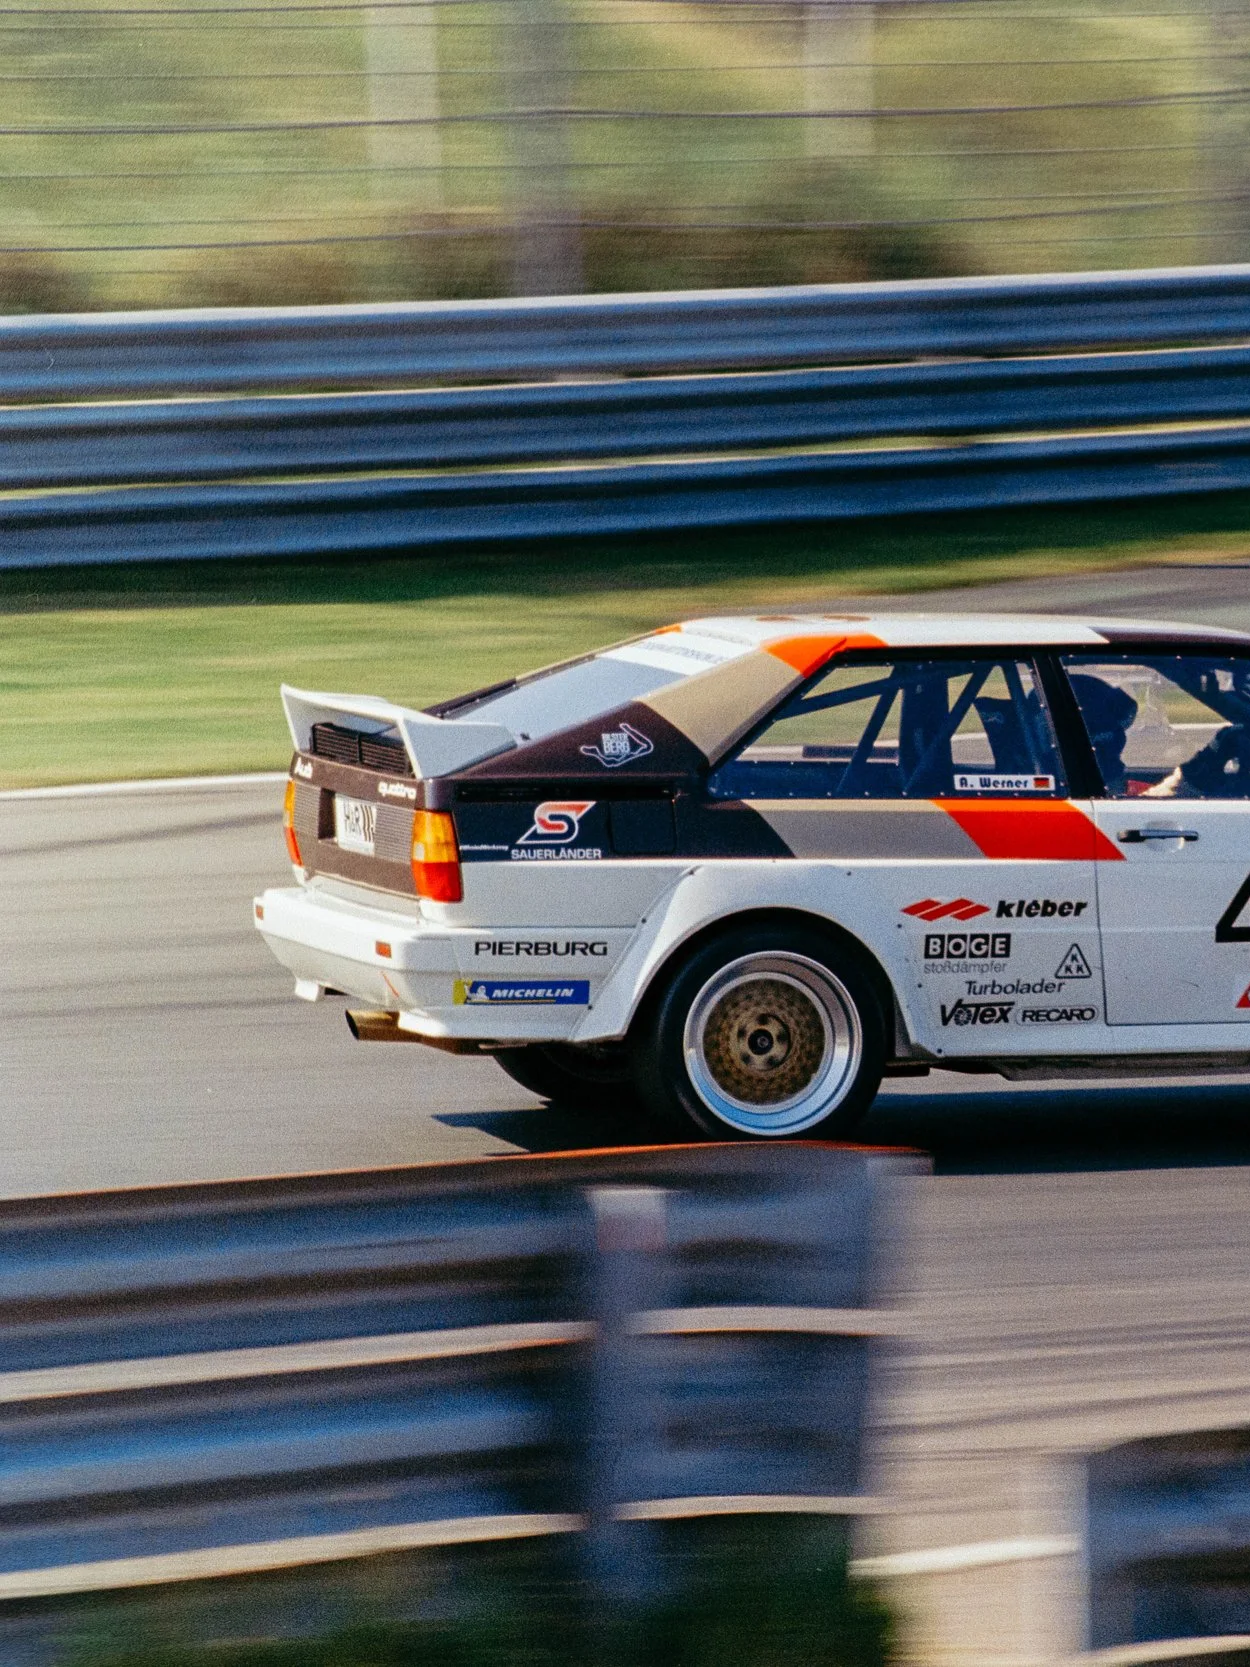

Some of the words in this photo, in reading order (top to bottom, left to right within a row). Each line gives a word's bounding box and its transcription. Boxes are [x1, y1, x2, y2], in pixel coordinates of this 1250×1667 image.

[603, 741, 630, 754] BERG
[979, 777, 1028, 788] Werner
[378, 781, 417, 800] quattro
[511, 847, 602, 860] SAUERLÄNDER
[475, 941, 608, 956] PIERBURG
[926, 935, 1010, 957] BOGE
[492, 988, 574, 998] MICHELIN
[965, 978, 1066, 996] Turbolader
[1021, 1008, 1096, 1023] RECARO
